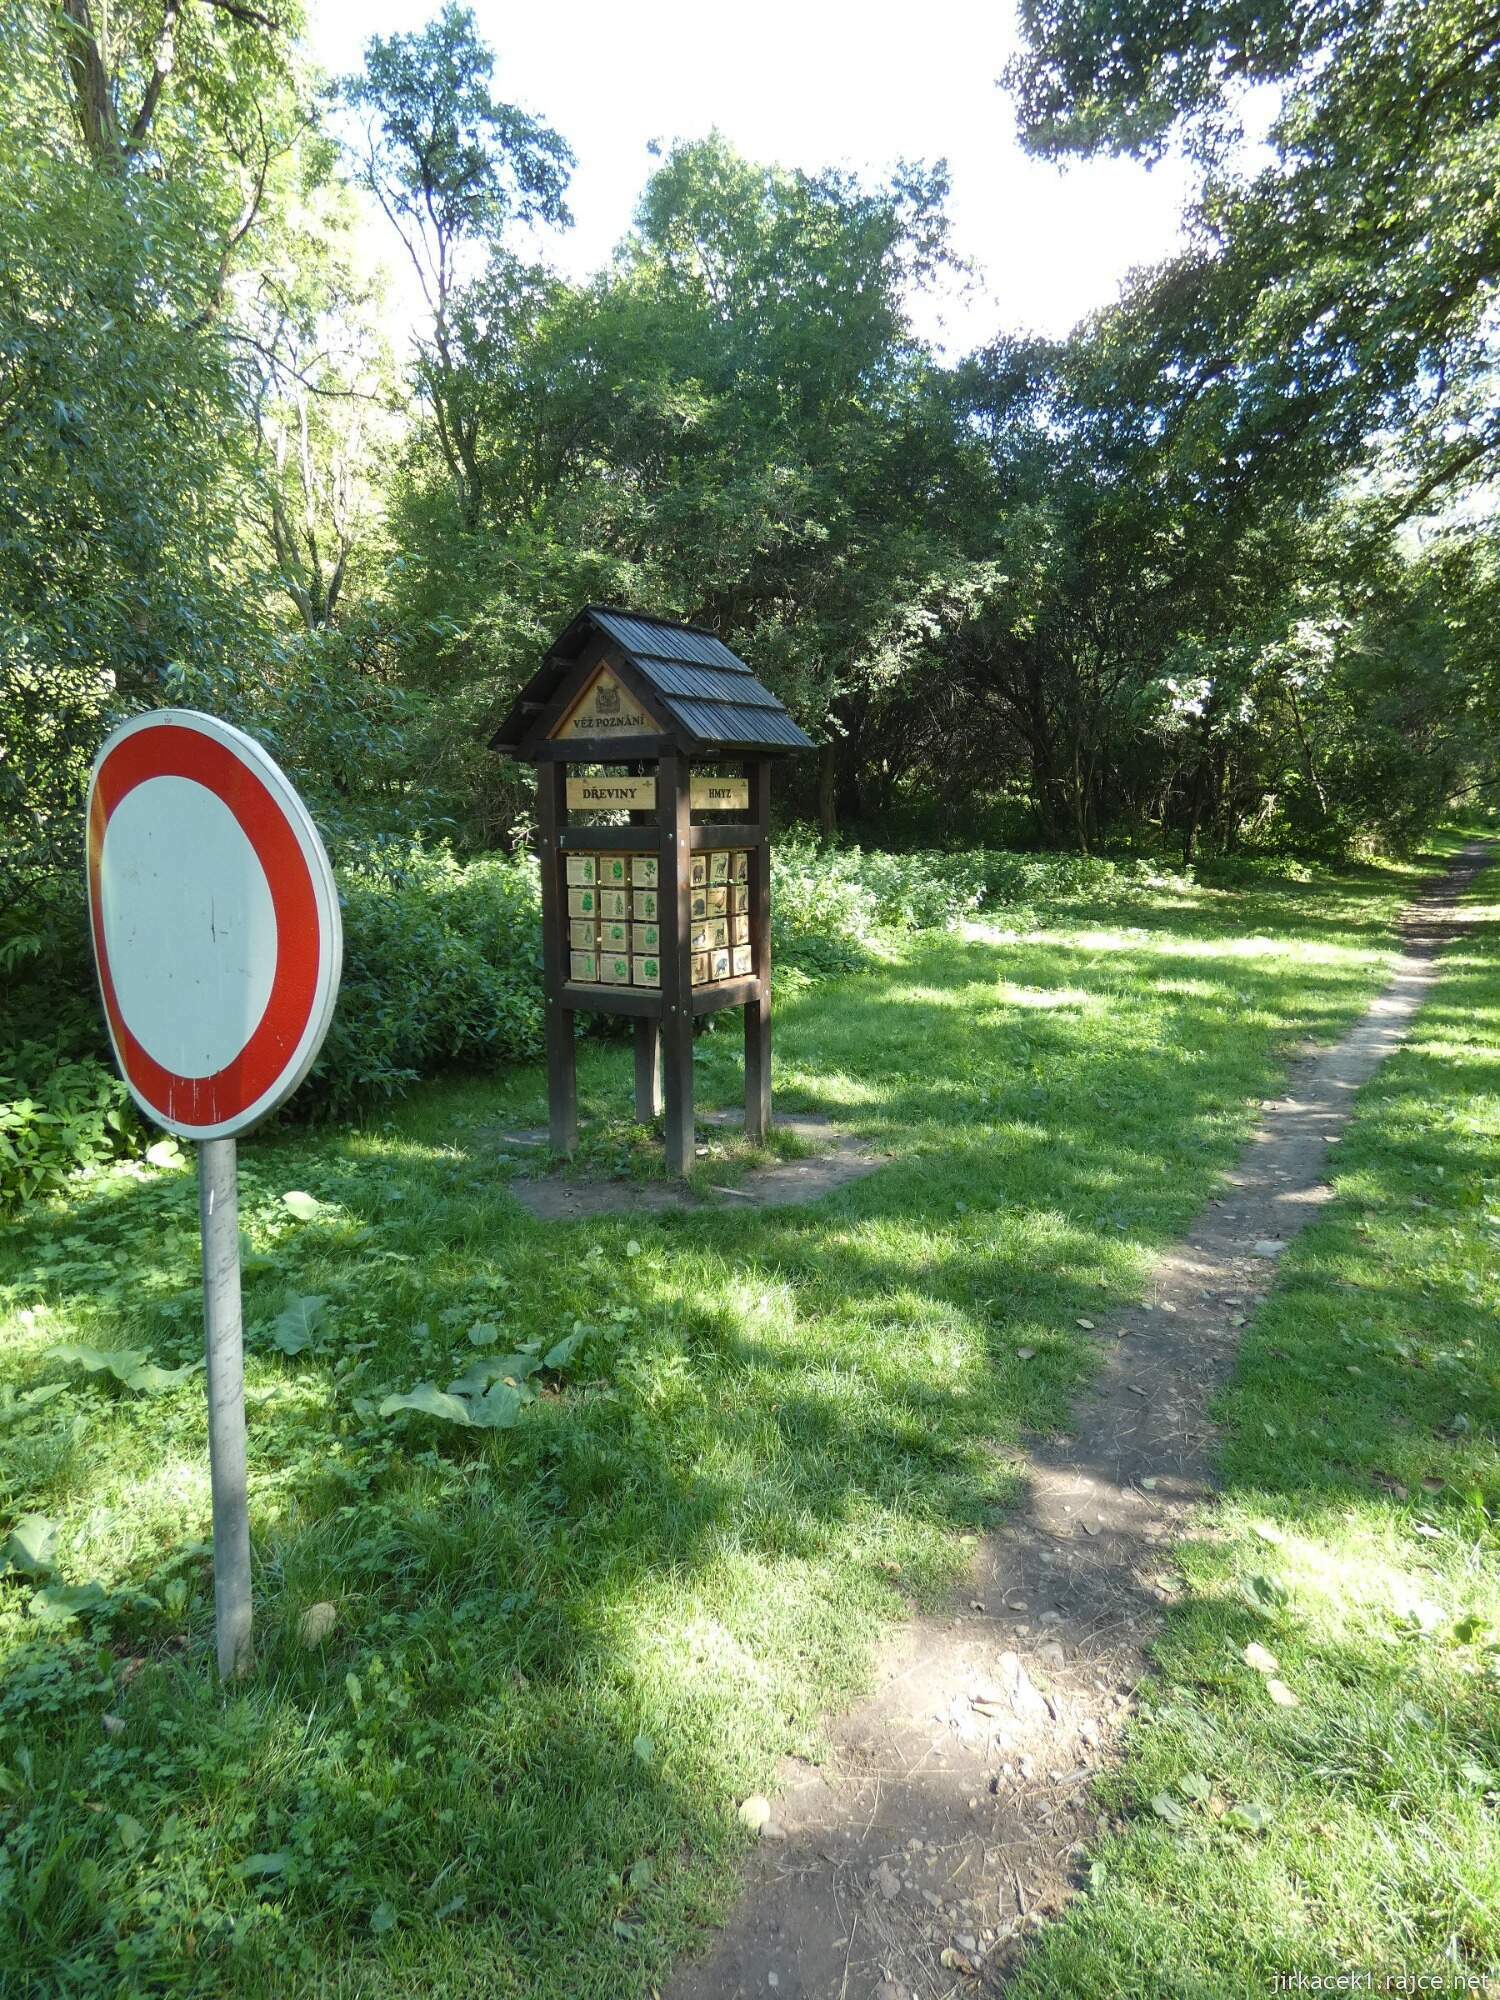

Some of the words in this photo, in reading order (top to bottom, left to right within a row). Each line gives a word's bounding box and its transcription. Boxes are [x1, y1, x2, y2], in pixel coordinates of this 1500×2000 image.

[597, 714, 645, 728] POZNÁNÍ
[583, 786, 637, 799] DŘEVINY
[709, 788, 732, 799] HMYZ
